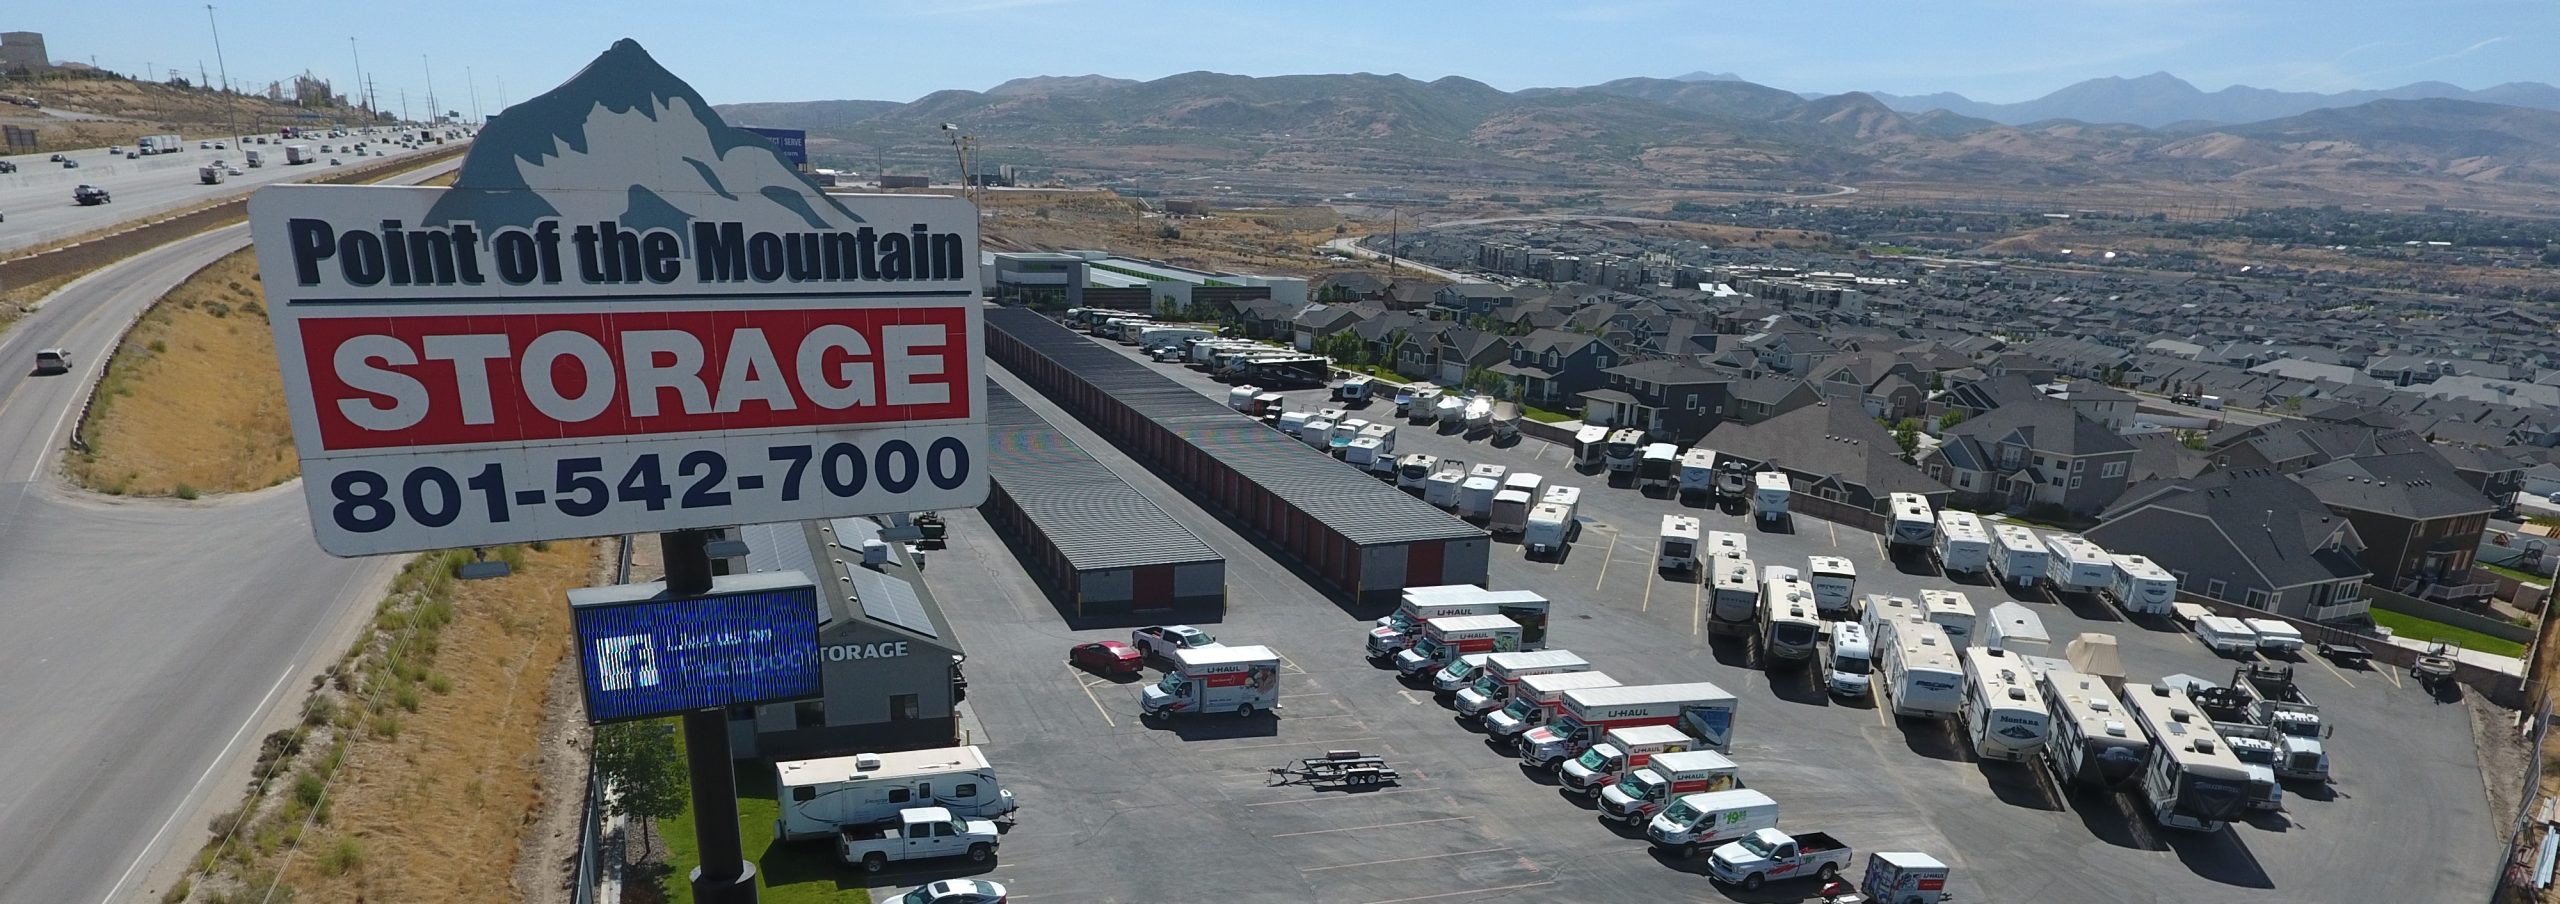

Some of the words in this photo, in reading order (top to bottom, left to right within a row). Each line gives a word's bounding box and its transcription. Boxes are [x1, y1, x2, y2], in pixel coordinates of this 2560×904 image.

[287, 218, 485, 287] Point
[494, 220, 563, 286] of
[571, 220, 681, 285] the
[694, 221, 964, 283] Mountain
[333, 323, 951, 431] STORAGE
[331, 436, 970, 533] 801-542-7000
[1437, 608, 1473, 616] U-HAUL
[1460, 632, 1489, 640] U-HAUL
[820, 641, 909, 662] TORAGE
[1207, 665, 1241, 674] U-HAUL
[1608, 708, 1649, 718] U-HAUL
[2000, 715, 2039, 726] Montana
